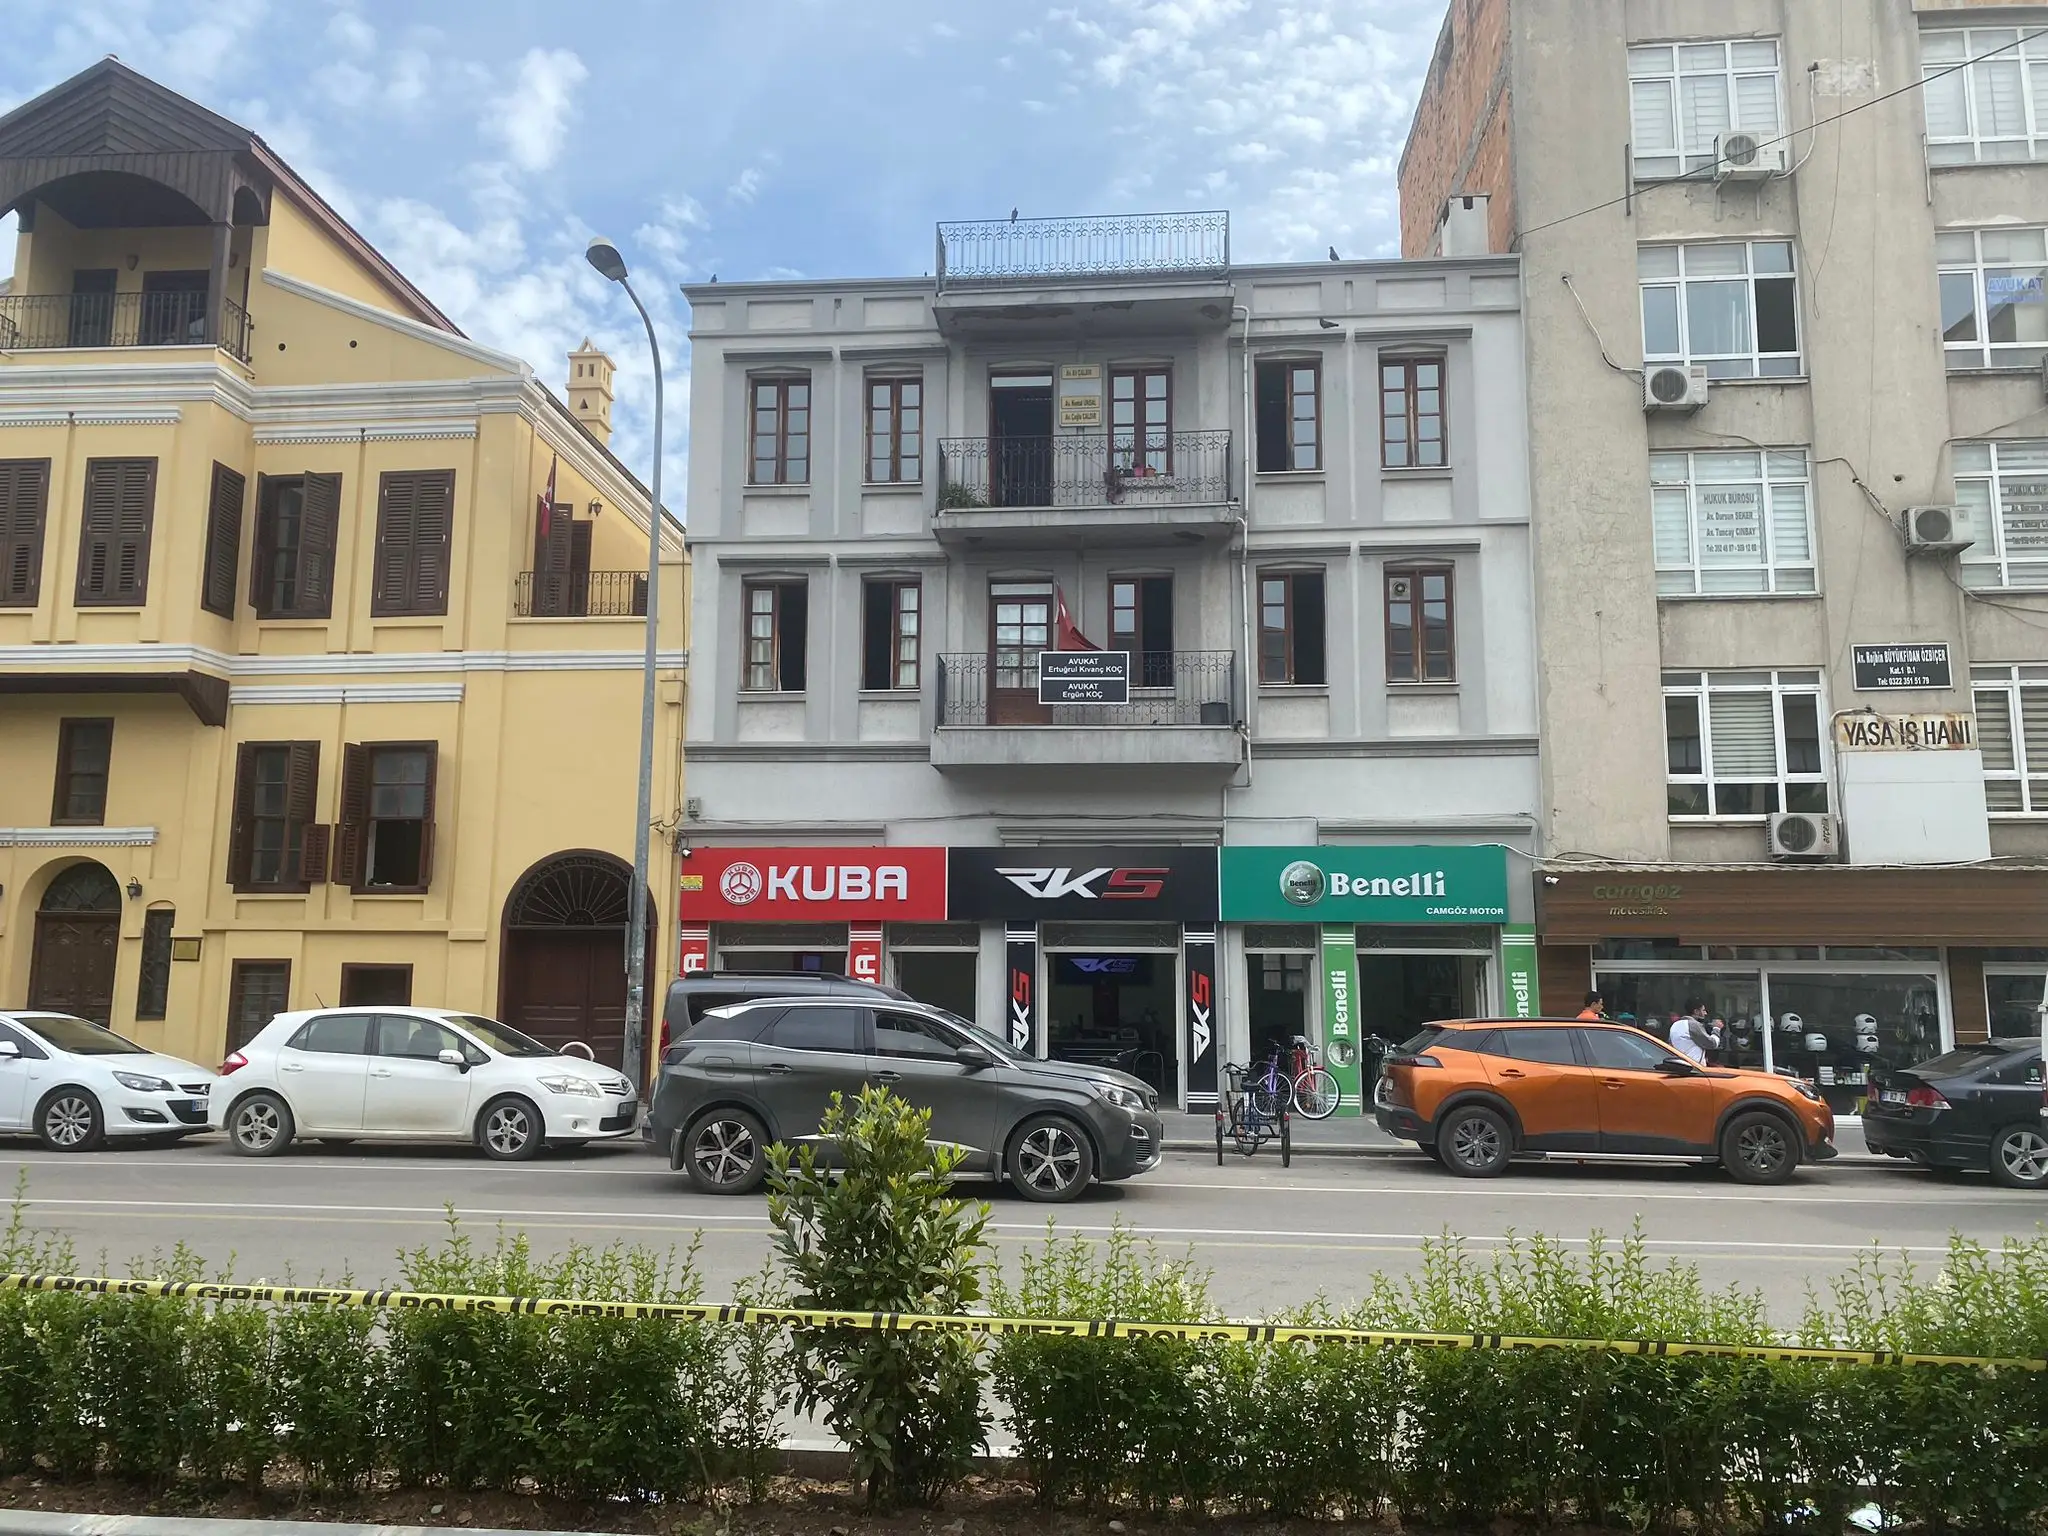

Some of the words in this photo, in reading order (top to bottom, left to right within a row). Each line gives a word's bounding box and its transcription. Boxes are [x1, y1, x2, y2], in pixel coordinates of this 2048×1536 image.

[1987, 277, 2043, 291] AVUKAT
[1703, 493, 1727, 504] HUKUK
[1048, 666, 1078, 674] Ertuğrul
[1079, 666, 1104, 674] Kıvanç
[1105, 665, 1123, 674] KOÇ
[1889, 677, 1903, 686] 0322
[1903, 677, 1913, 685] 351
[1914, 676, 1921, 684] 51
[1062, 691, 1085, 699] Ergün
[1085, 691, 1103, 699] KOÇ
[1843, 721, 1895, 746] YASA
[1923, 720, 1971, 745] HANI
[728, 865, 755, 876] KUBA
[767, 865, 908, 900] KUBA
[994, 867, 1169, 898] RKS
[1329, 870, 1446, 896] Benelli
[724, 888, 756, 901] MOTOR
[1426, 906, 1468, 915] CAMGÖZ
[1469, 907, 1504, 915] MOTOR
[1511, 971, 1529, 1018] nelli
[1330, 970, 1348, 1036] Benelli
[1191, 970, 1211, 1065] RKS
